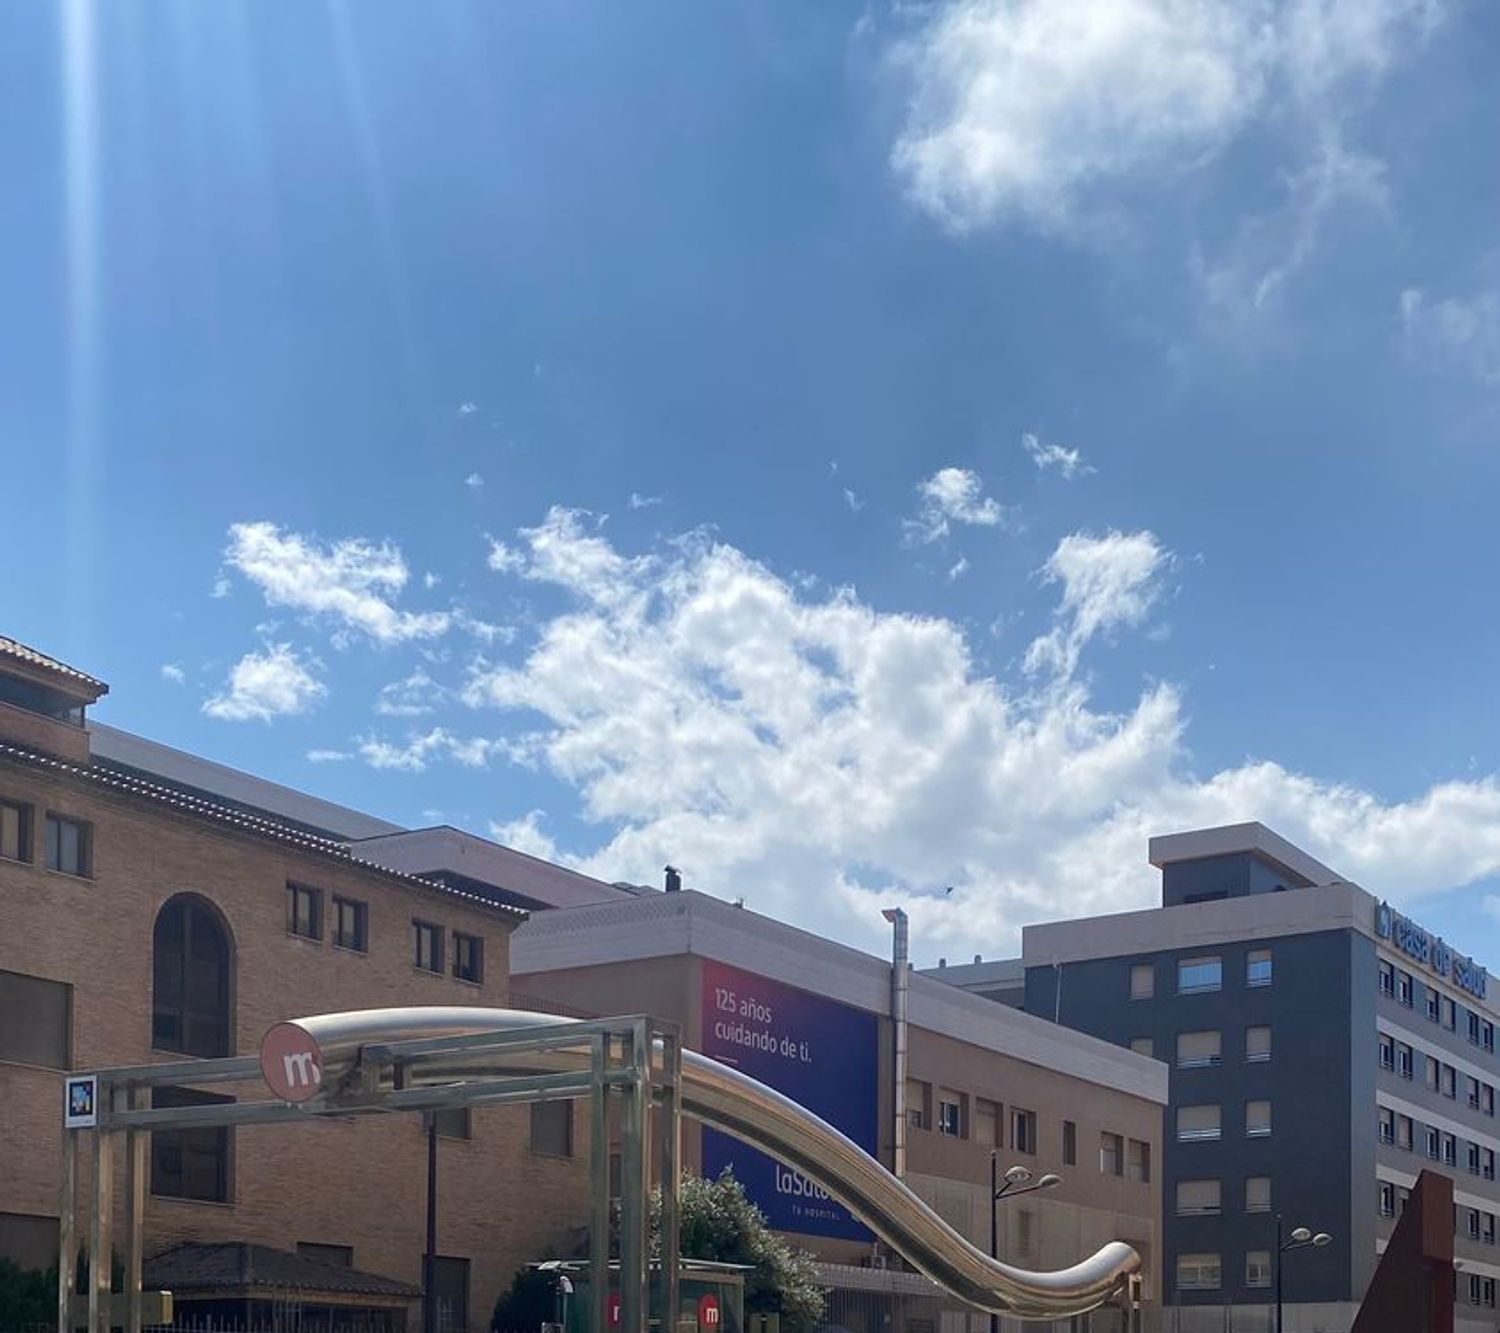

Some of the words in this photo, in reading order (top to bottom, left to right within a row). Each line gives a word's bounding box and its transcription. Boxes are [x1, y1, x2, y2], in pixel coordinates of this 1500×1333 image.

[715, 987, 737, 1013] 125
[740, 997, 772, 1023] años
[715, 1021, 778, 1054] cuidando
[780, 1036, 797, 1058] de
[799, 1041, 812, 1063] ti.
[283, 1052, 320, 1088] m
[706, 1308, 719, 1323] m
